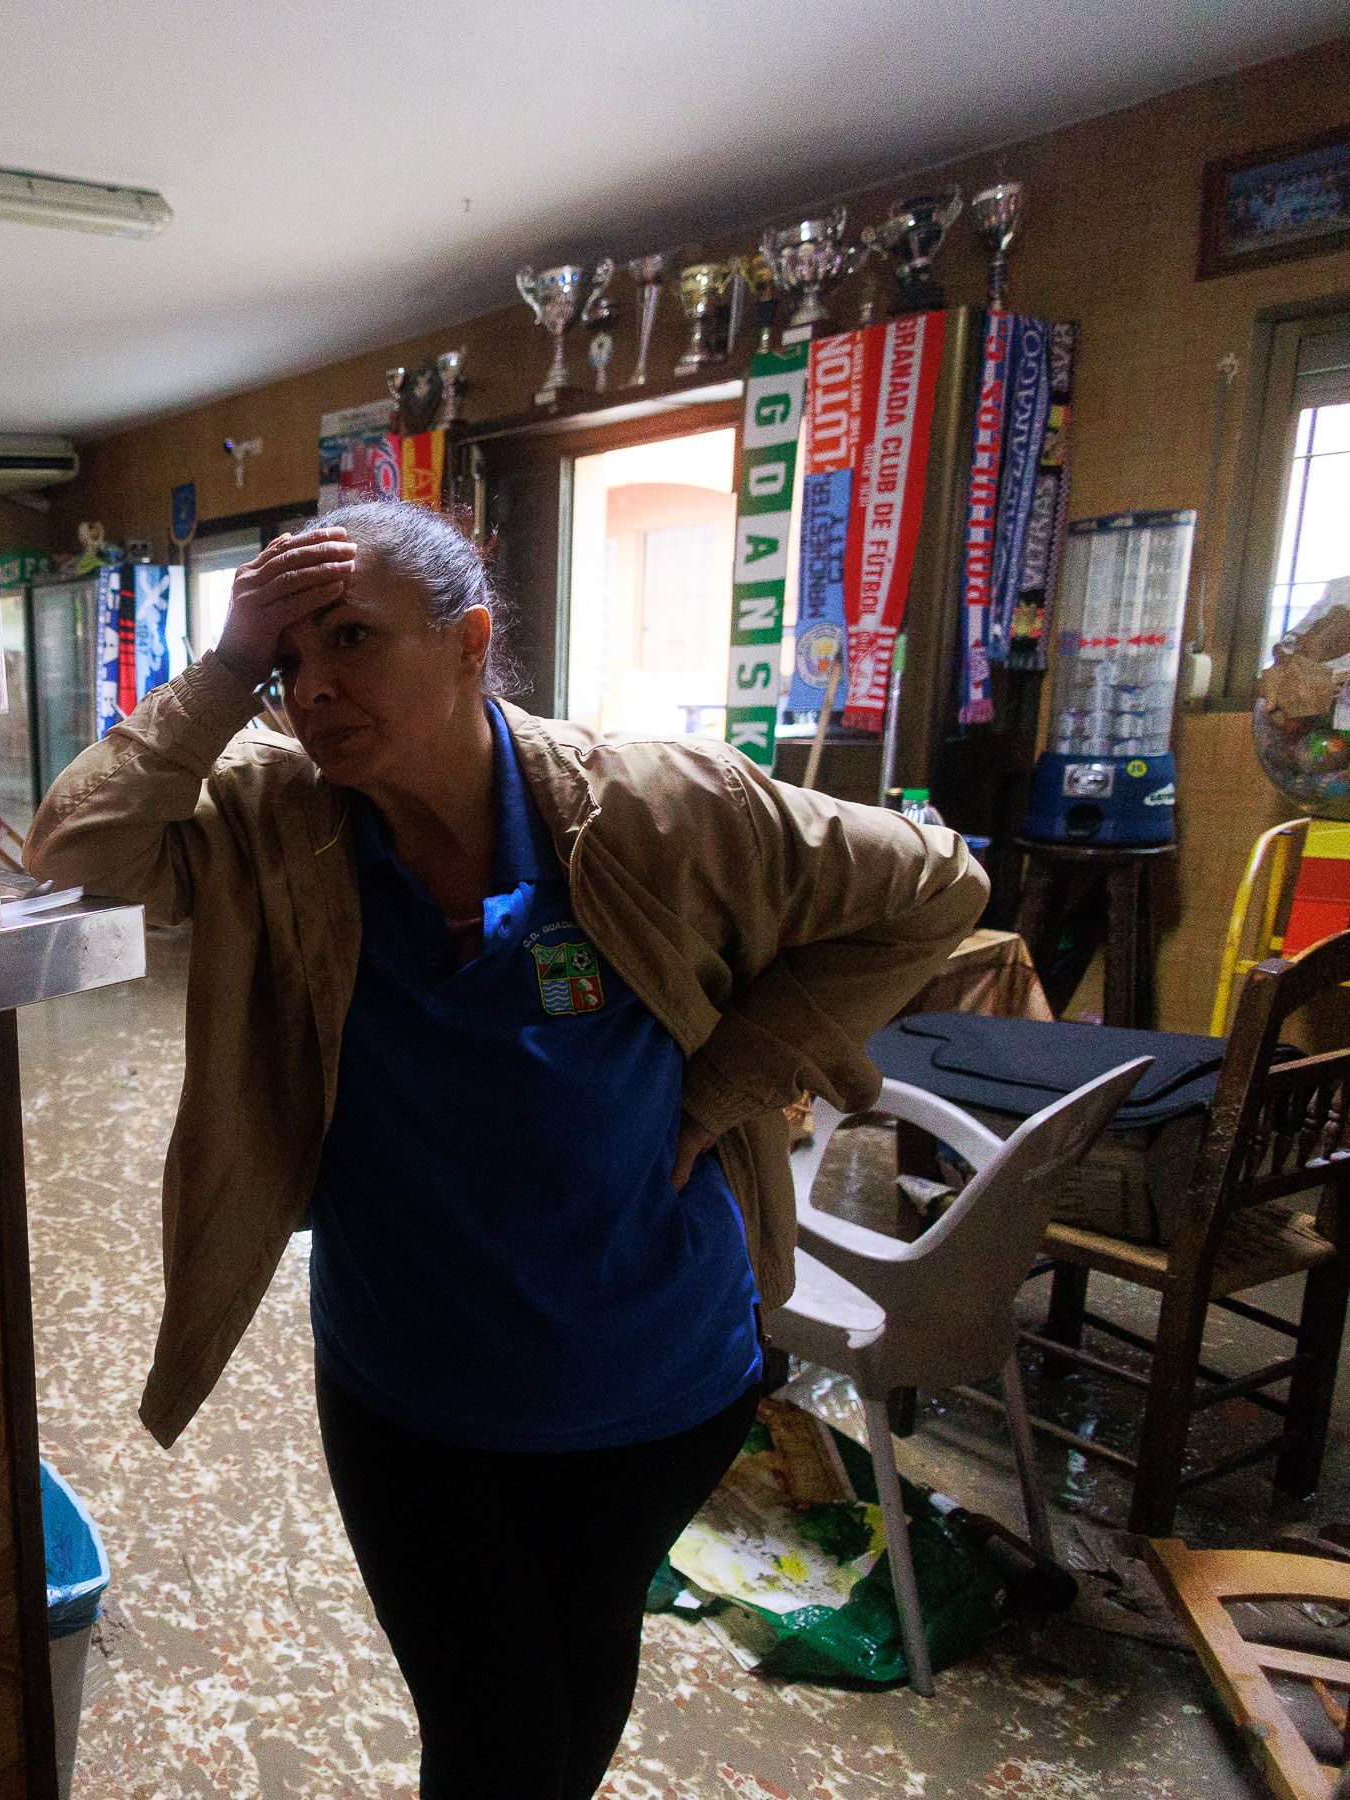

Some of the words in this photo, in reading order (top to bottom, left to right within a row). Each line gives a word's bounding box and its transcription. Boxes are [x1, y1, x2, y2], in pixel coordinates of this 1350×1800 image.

[814, 330, 852, 472] LUTON
[884, 319, 919, 427] GRANADA
[877, 436, 903, 494] CLUB
[870, 504, 895, 531] DE
